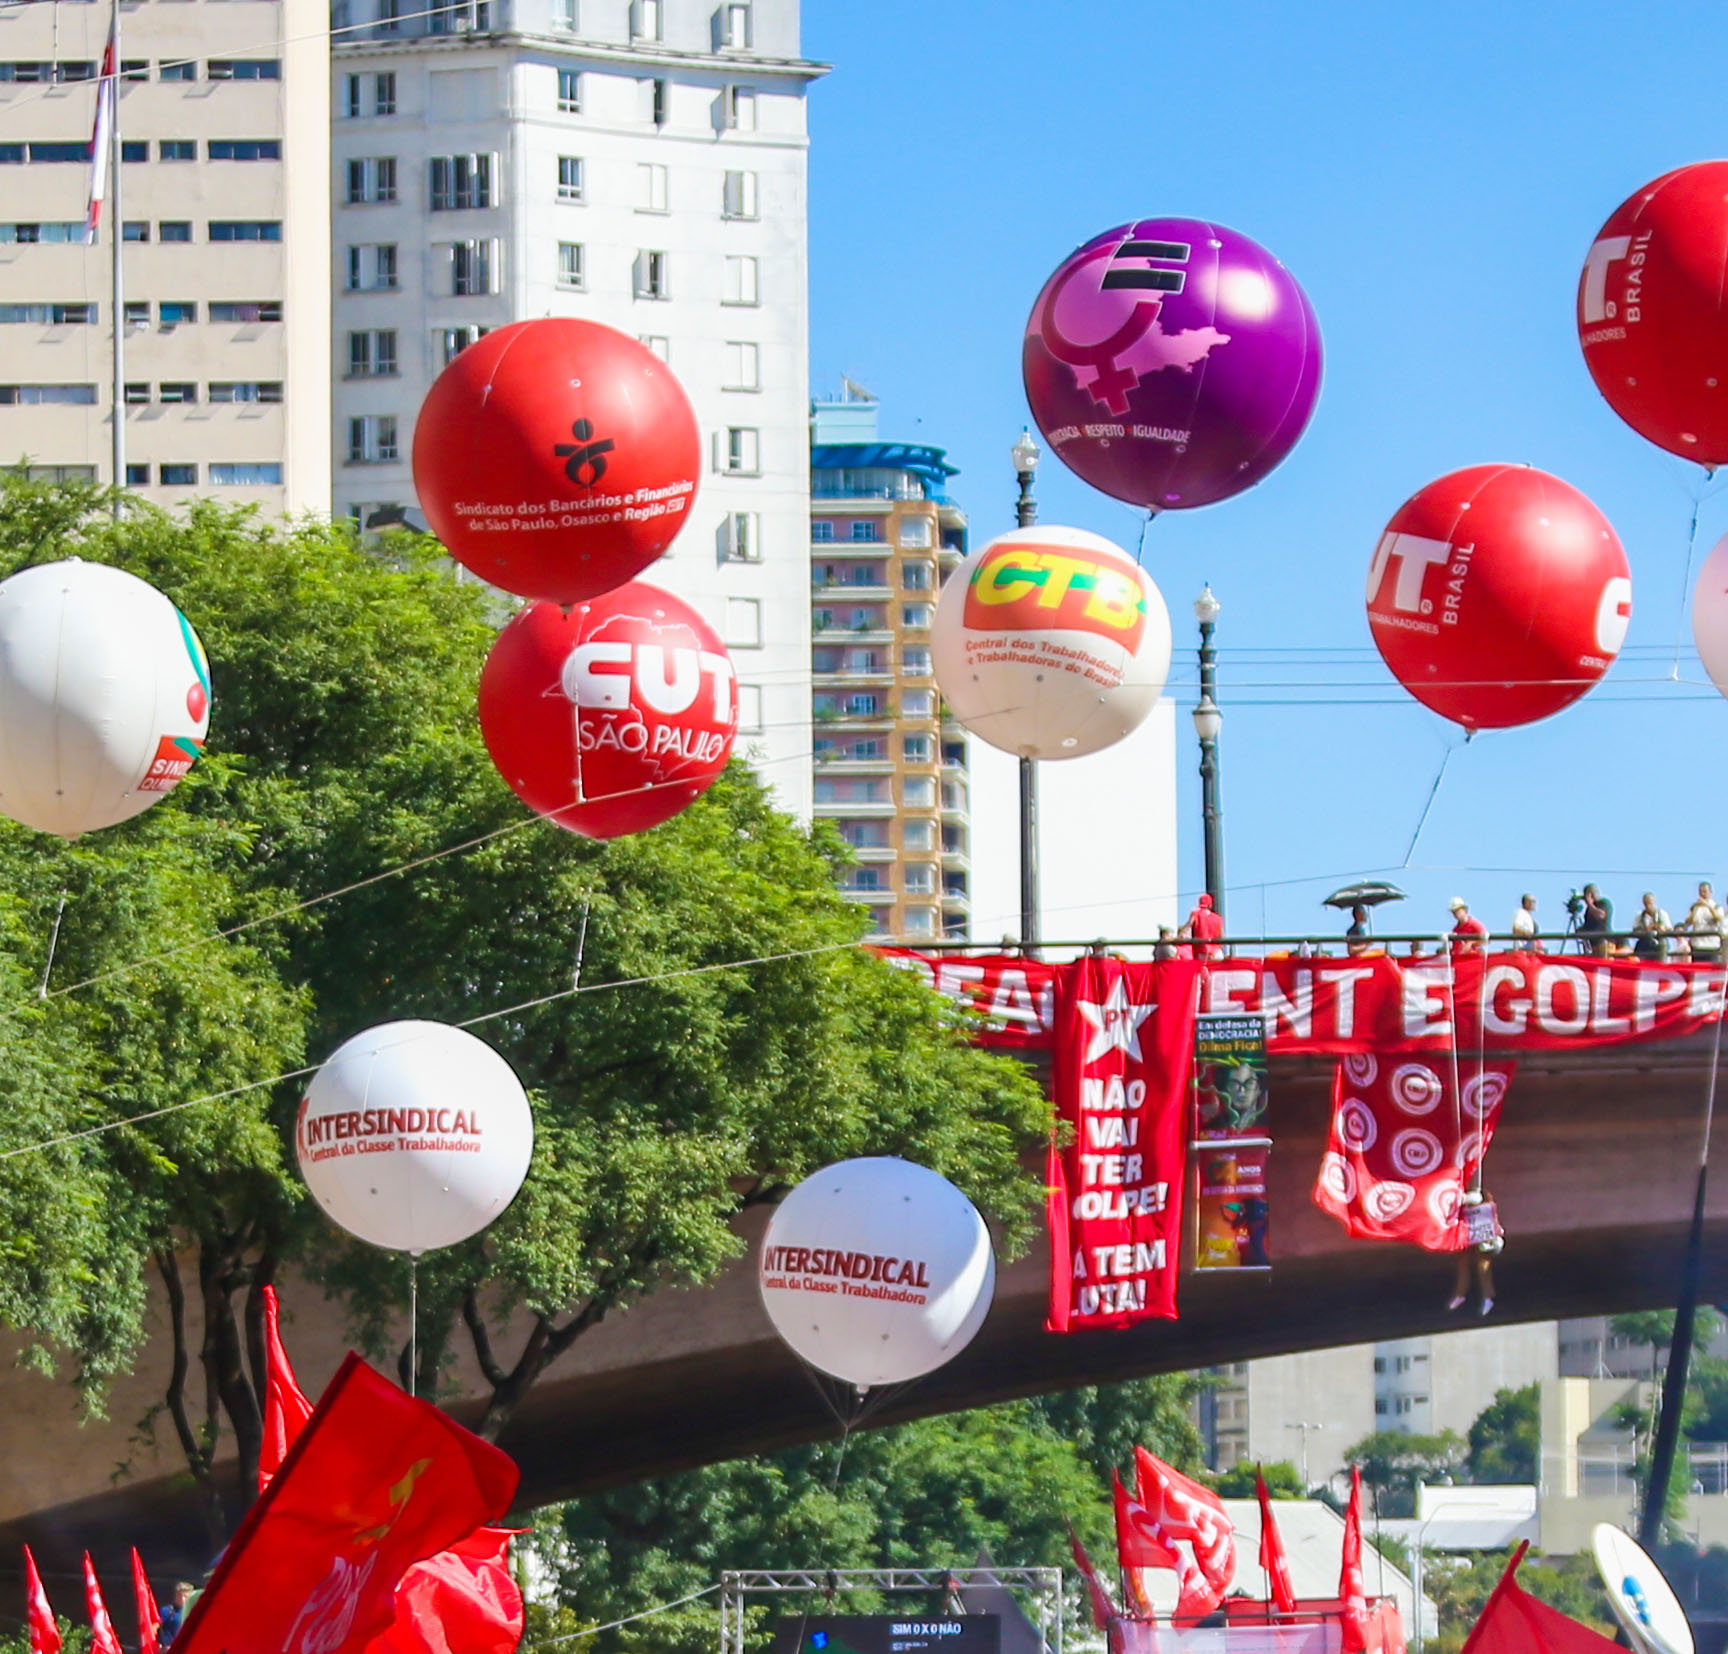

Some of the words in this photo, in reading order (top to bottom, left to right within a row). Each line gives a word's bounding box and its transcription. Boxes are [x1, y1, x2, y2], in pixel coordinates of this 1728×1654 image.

[1626, 229, 1653, 323] BRASIL
[1133, 424, 1192, 443] IGUALDADE
[454, 501, 514, 516] Sindicato
[518, 500, 546, 515] dos
[550, 494, 622, 514] Bancários
[624, 494, 634, 505] e
[469, 518, 485, 531] de
[486, 518, 510, 531] São
[561, 512, 610, 528] Osasco
[613, 511, 622, 521] e
[625, 502, 665, 523] Região
[975, 550, 1142, 630] CTB
[1443, 542, 1475, 625] BRASIL
[966, 637, 1008, 651] Central
[1012, 638, 1035, 650] dos
[977, 651, 1062, 669] Trabalhadoras
[1065, 660, 1081, 673] do
[561, 641, 740, 726] CUT
[579, 713, 649, 753] SÃO
[653, 723, 725, 764] PAULO
[1082, 1075, 1147, 1110] NÃO
[308, 1107, 483, 1146] INTERSINDICAL
[1085, 1116, 1138, 1149] VAI
[343, 1143, 355, 1155] da
[357, 1139, 395, 1154] Classe
[398, 1137, 481, 1153] Trabalhadora
[1081, 1153, 1143, 1186] TER
[764, 1246, 930, 1288] NTERSINDICAL
[1094, 1238, 1168, 1278] TEM
[803, 1277, 838, 1294] Classe
[841, 1281, 927, 1305] Trabalhadora
